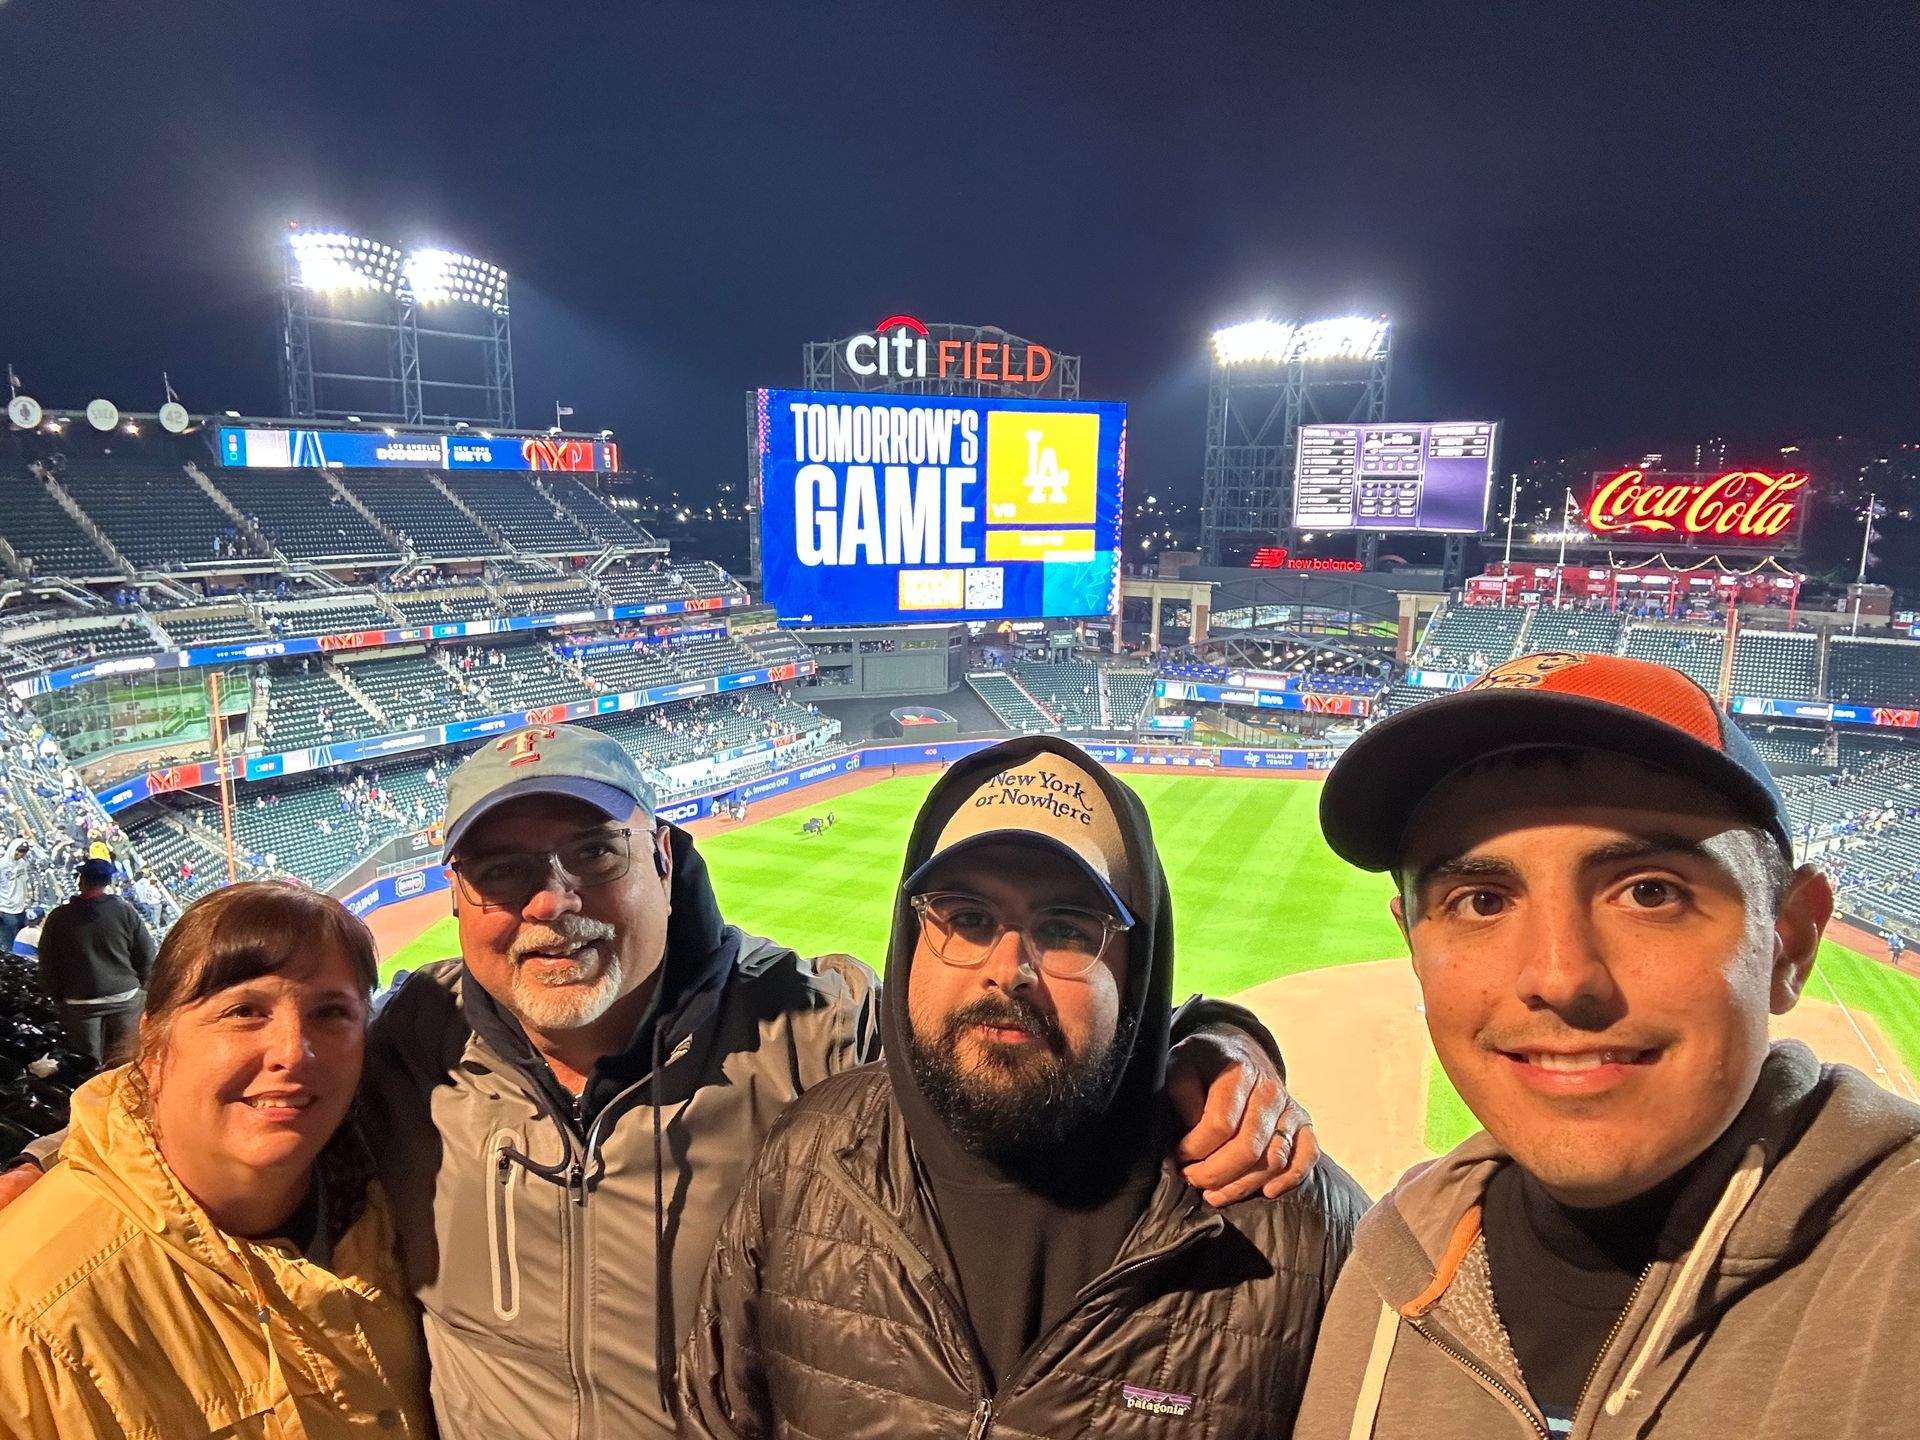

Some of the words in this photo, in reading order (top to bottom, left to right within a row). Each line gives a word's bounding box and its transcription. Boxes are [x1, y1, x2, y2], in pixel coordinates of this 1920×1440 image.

[845, 326, 927, 378] citi
[938, 340, 1052, 383] FIELD
[165, 410, 183, 424] 42
[790, 403, 979, 465] TOMORROW'S
[376, 449, 441, 461] DODGERS
[454, 451, 492, 463] METS
[1023, 429, 1069, 504] LA
[794, 464, 977, 567] GAME
[1588, 469, 1809, 536] Coca-Cola
[1287, 559, 1313, 569] new
[1313, 558, 1364, 571] balance
[496, 726, 555, 768] T
[845, 756, 860, 770] citi
[975, 794, 999, 808] or
[999, 788, 1091, 825] Nowhere
[986, 771, 1036, 788] New
[1039, 771, 1093, 811] York
[1127, 1398, 1186, 1416] patagonia
